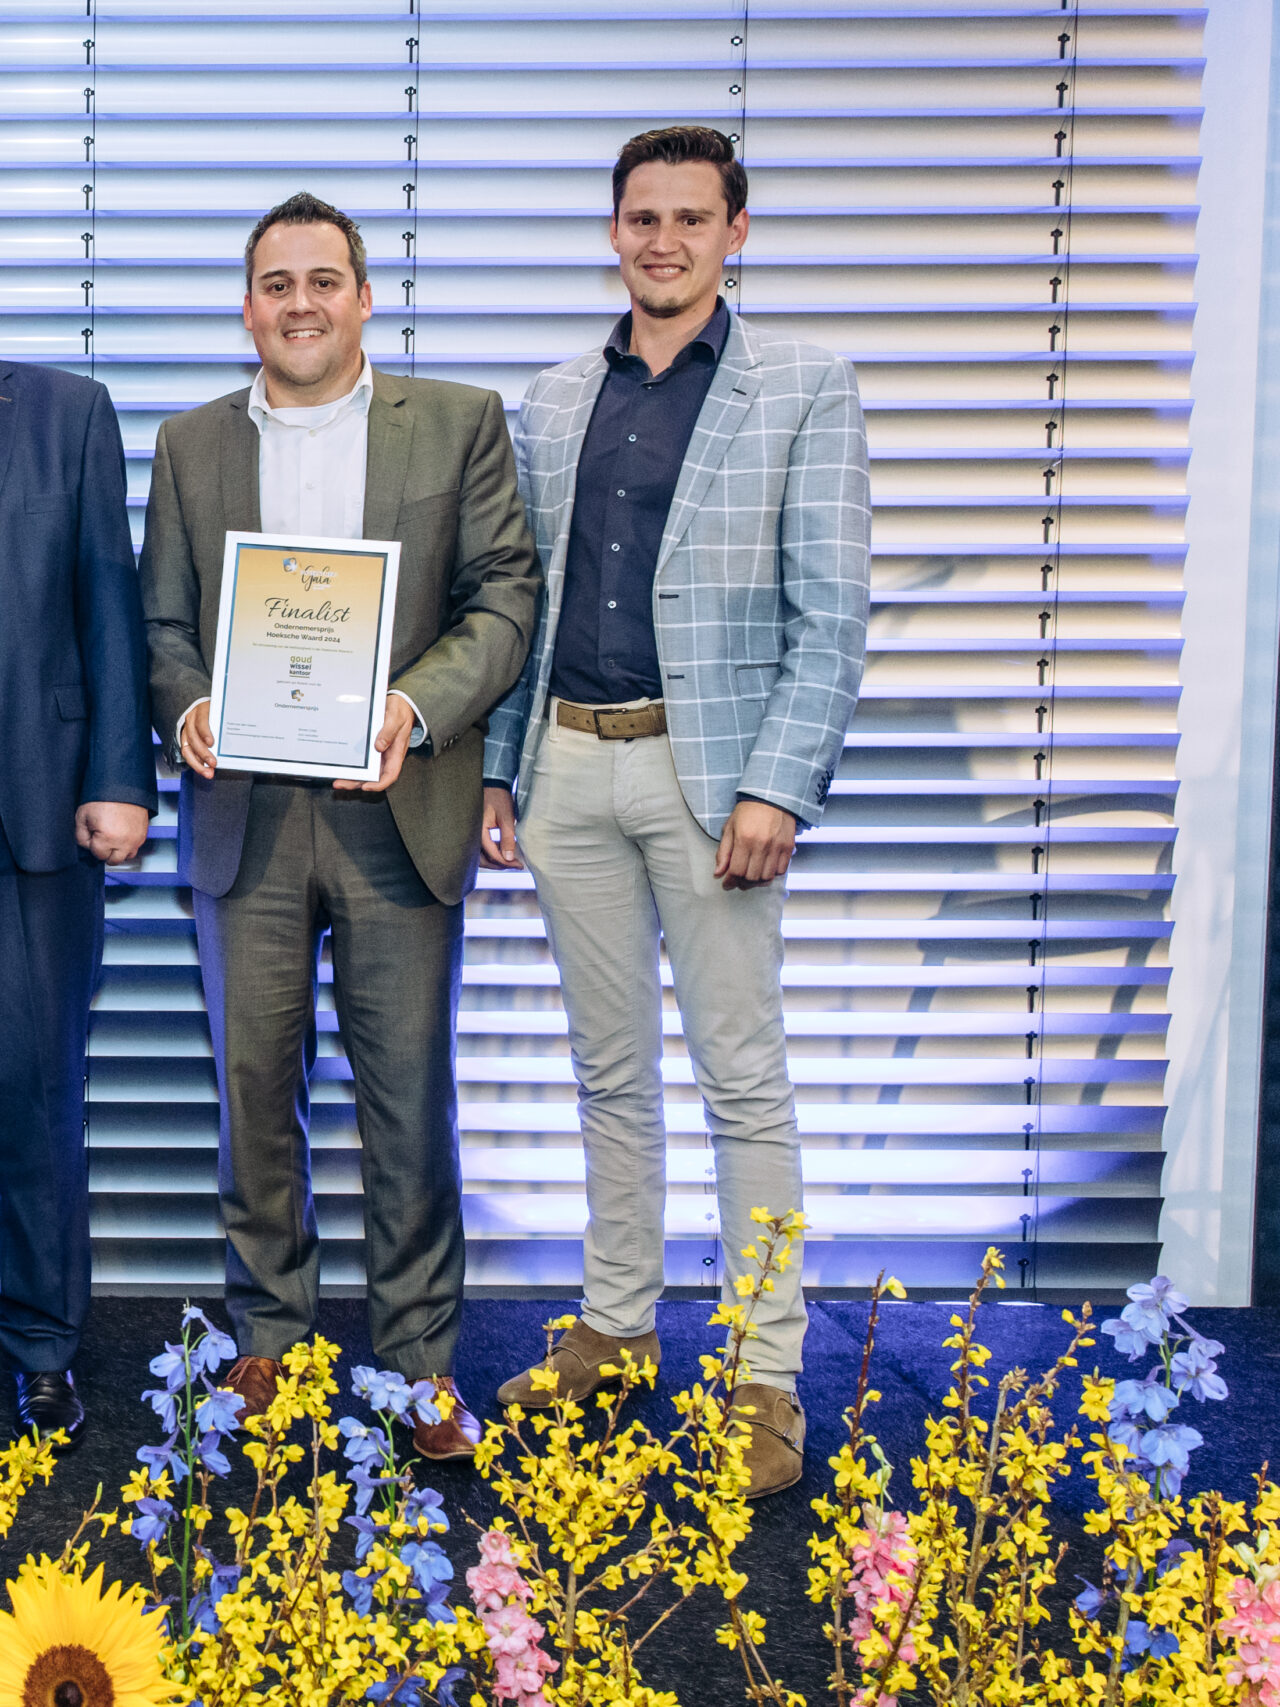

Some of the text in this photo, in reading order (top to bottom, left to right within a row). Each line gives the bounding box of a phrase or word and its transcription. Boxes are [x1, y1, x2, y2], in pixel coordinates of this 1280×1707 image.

[264, 597, 353, 624] Finalist
[274, 622, 335, 634] Ondernemersprijs
[266, 631, 341, 644] Hoeksche Waard 2024
[290, 655, 312, 664] goud
[290, 662, 312, 670] wissel
